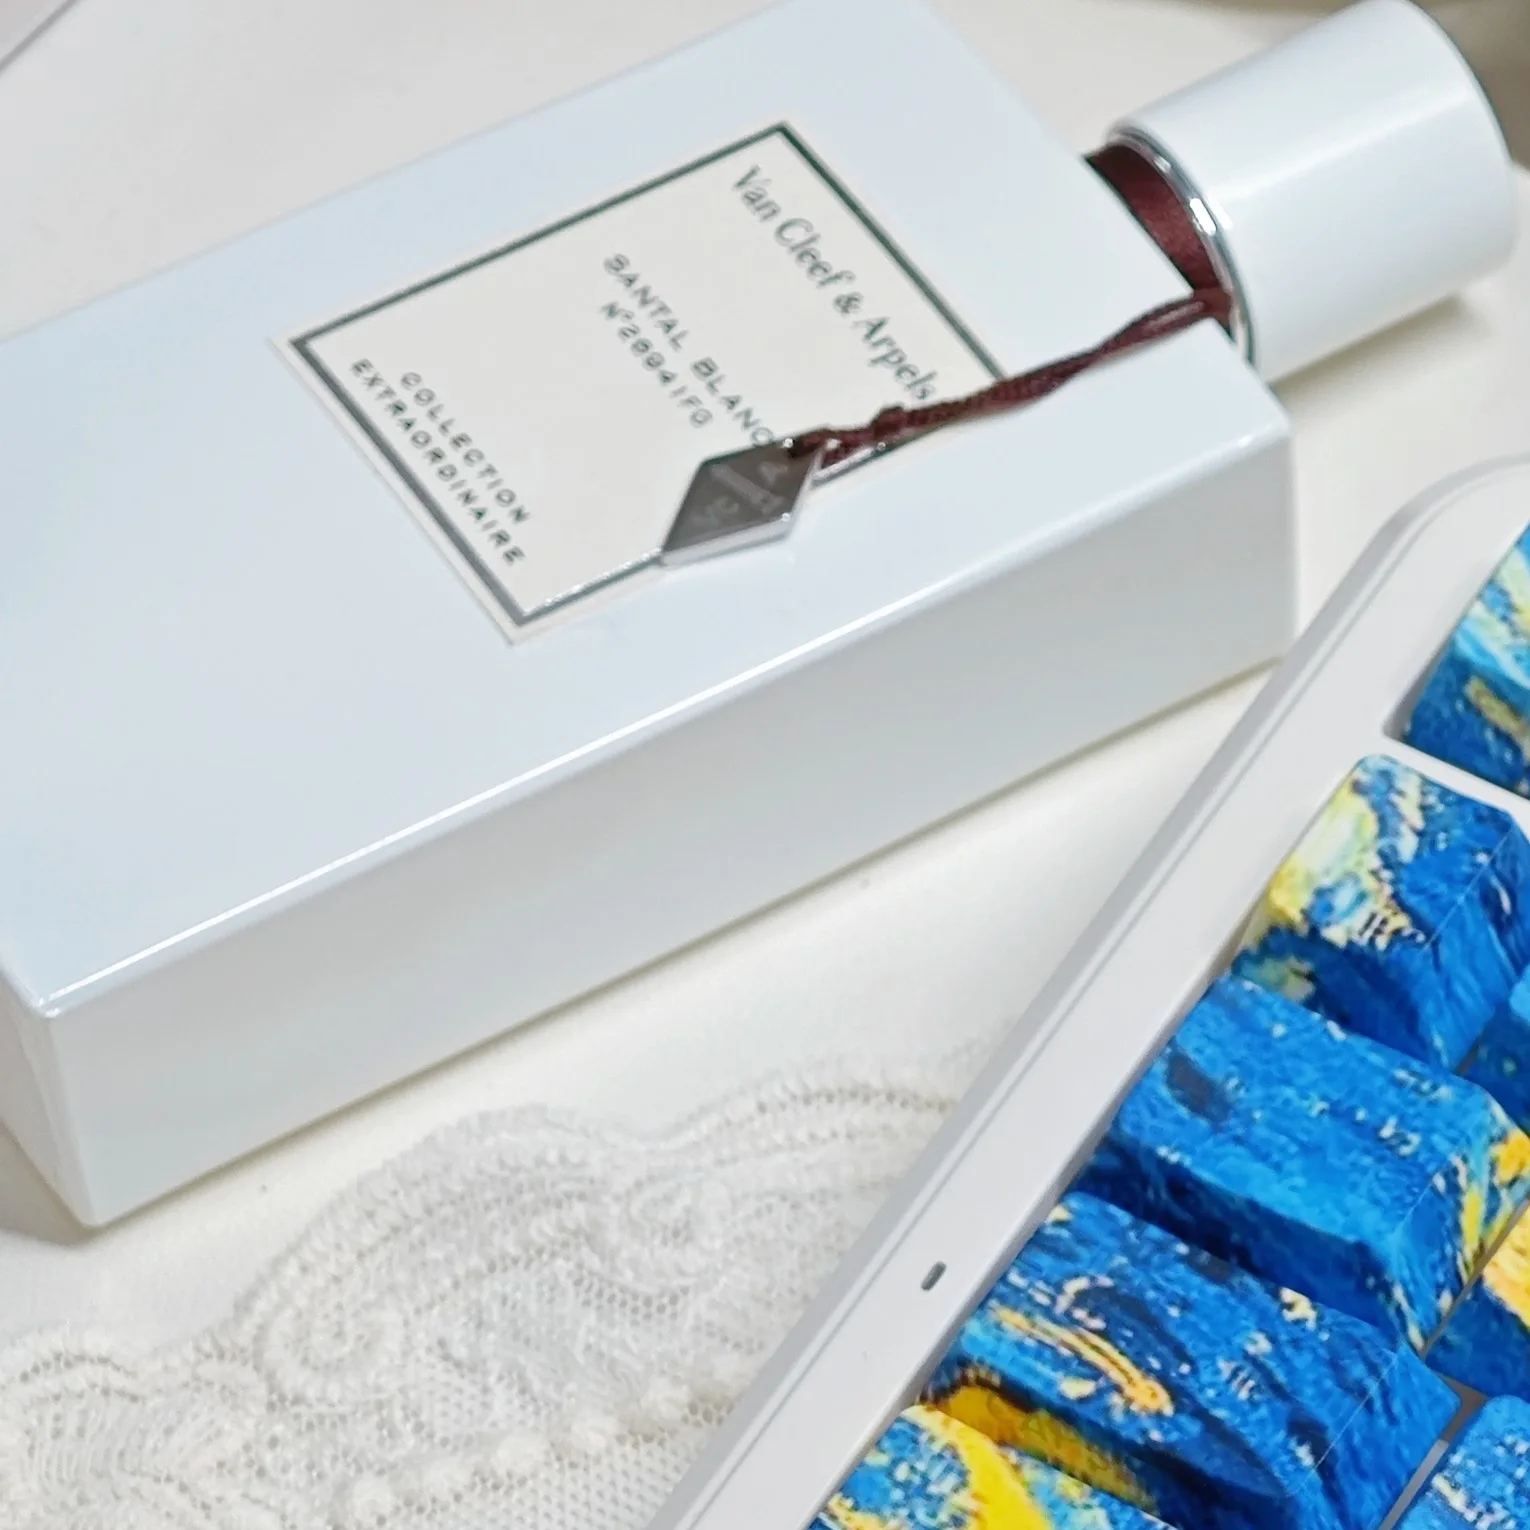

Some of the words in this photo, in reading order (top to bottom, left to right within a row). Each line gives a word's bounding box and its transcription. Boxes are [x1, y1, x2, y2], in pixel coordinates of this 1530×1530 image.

[603, 253, 688, 352] SANTAL
[733, 165, 782, 222] Van
[774, 217, 856, 289] Cleef
[832, 291, 864, 316] &
[851, 316, 938, 400] Arpels
[350, 358, 525, 566] EXTRAORDINAIRE
[400, 371, 530, 524] COLLECTION
